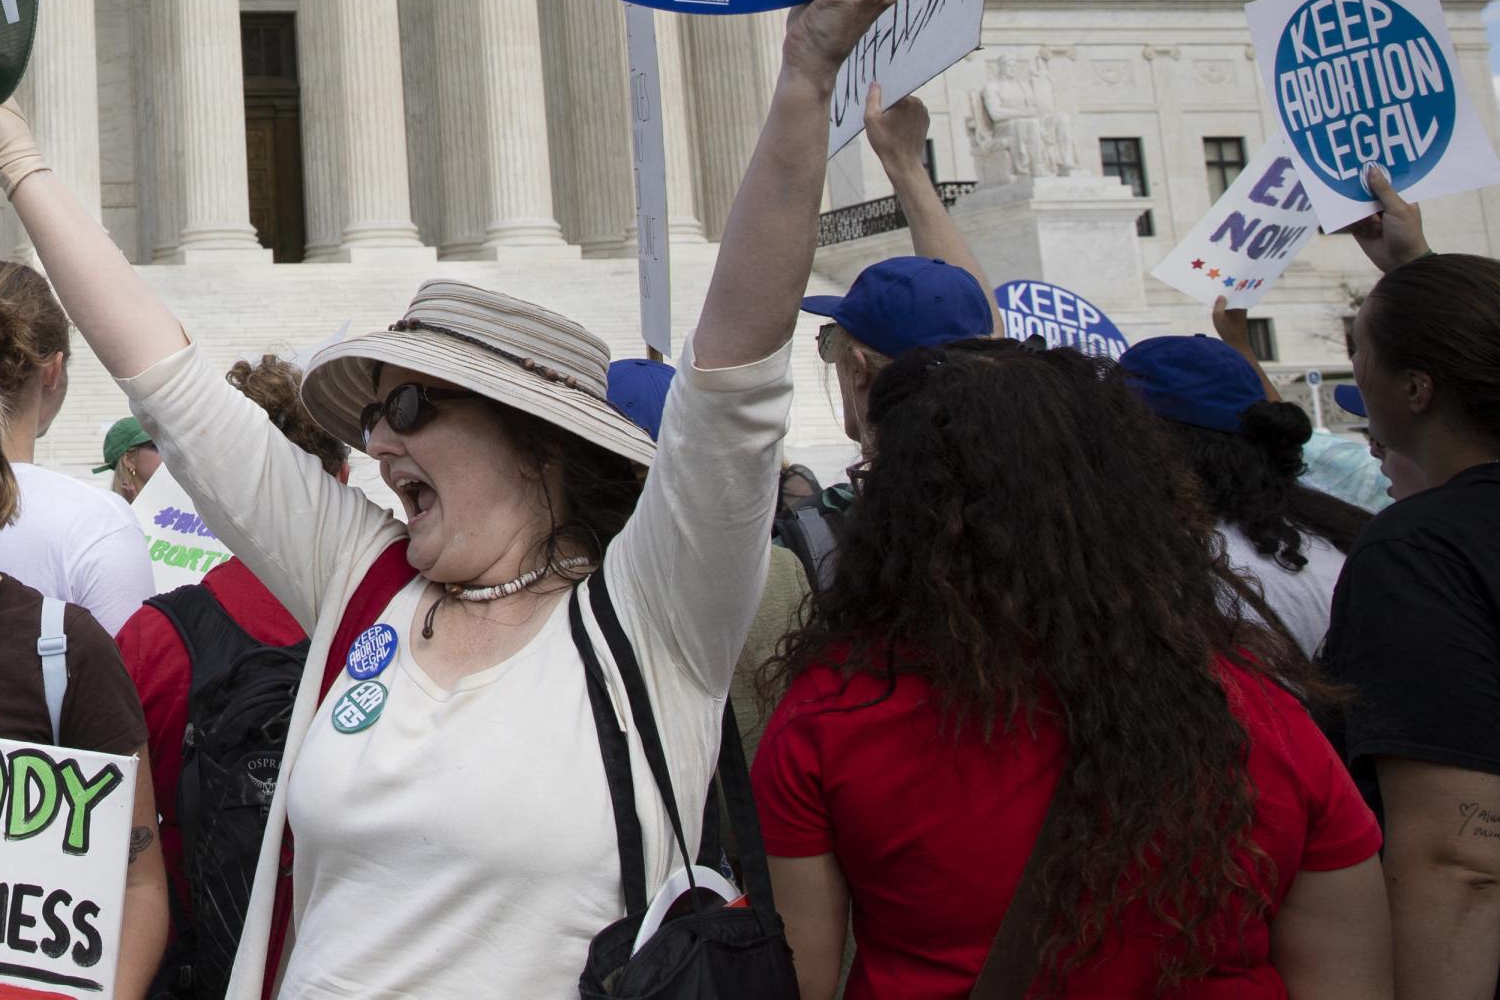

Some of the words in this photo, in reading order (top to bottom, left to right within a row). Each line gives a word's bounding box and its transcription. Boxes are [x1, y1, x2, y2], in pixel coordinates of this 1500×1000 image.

[1280, 37, 1445, 131] ABORTION
[1305, 102, 1440, 180] LEGAL
[1209, 210, 1308, 260] NOW!
[1007, 282, 1101, 331] KEEP
[145, 535, 231, 573] BORT
[349, 630, 393, 666] ABORTION
[354, 626, 382, 649] KEEP
[354, 646, 390, 672] LEGAL
[334, 696, 367, 728] YES
[350, 682, 383, 713] ERA
[247, 758, 283, 770] OSPR
